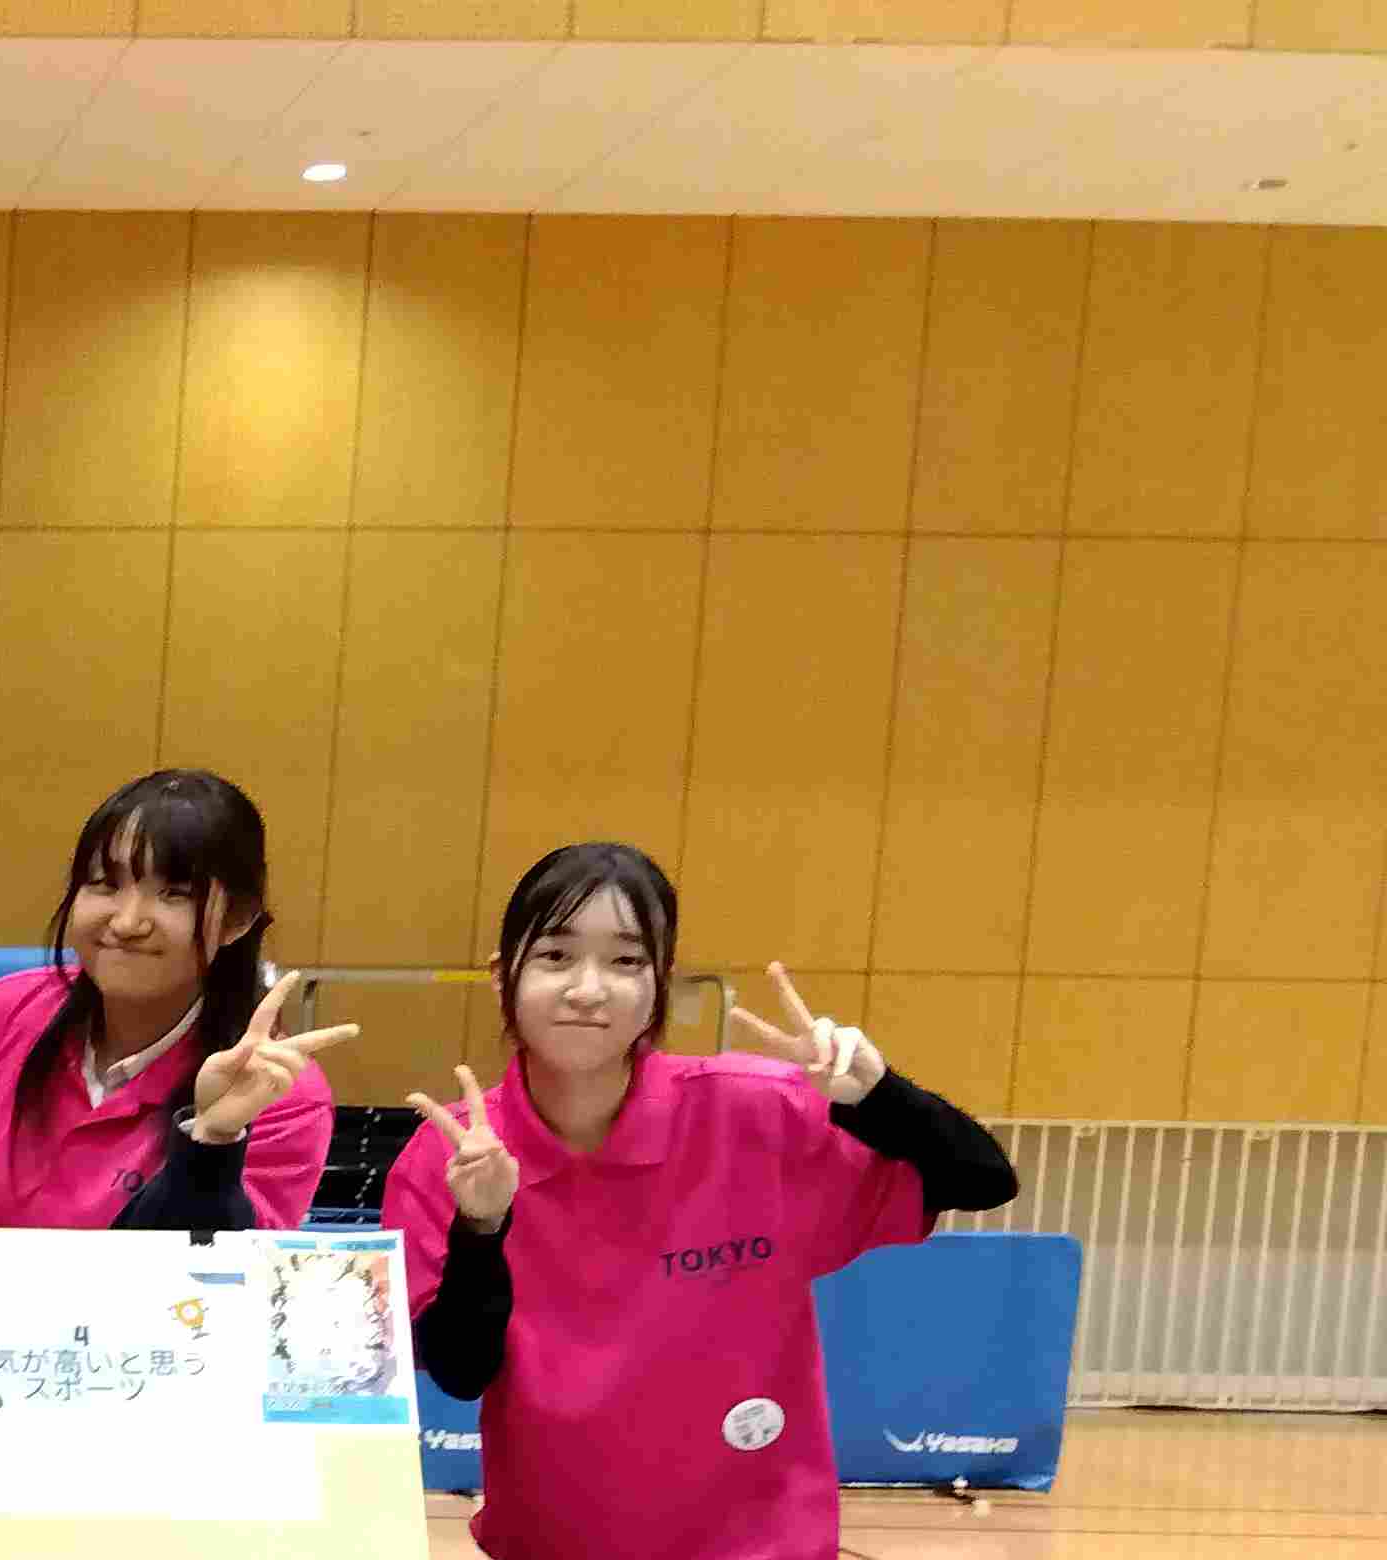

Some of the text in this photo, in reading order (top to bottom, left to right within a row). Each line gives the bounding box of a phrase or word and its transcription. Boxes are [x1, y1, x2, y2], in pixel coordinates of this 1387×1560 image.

[658, 1236, 773, 1278] TOKYO
[74, 1325, 90, 1346] 4
[25, 1376, 145, 1401] スポーツ
